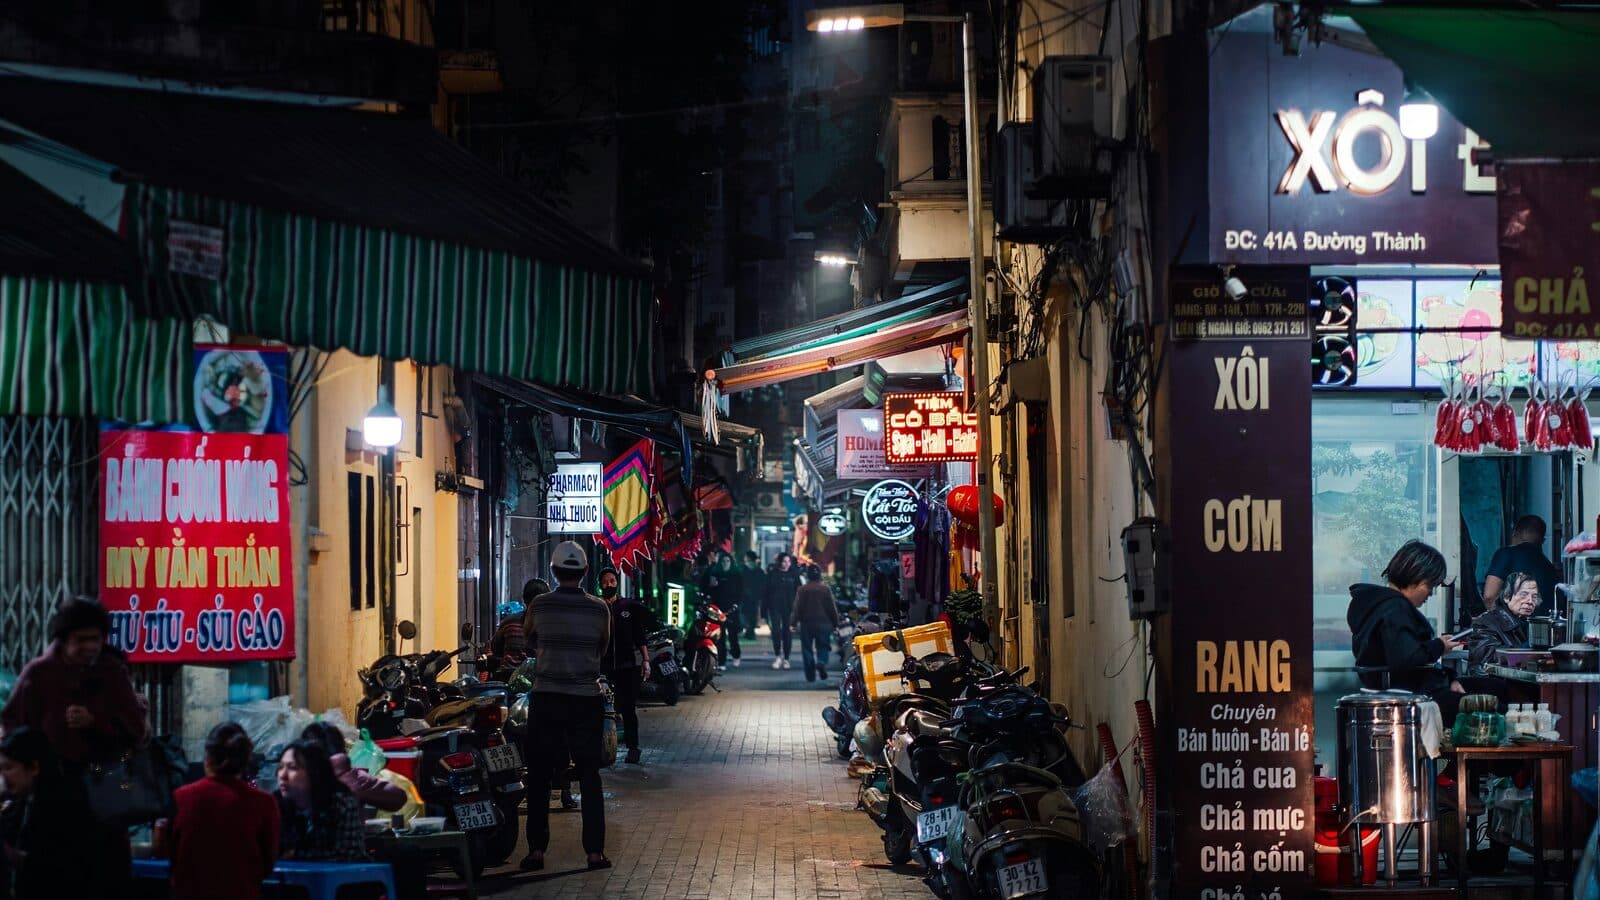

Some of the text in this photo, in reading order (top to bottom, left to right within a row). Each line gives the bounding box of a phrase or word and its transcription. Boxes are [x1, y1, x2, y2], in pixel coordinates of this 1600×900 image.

[1275, 88, 1428, 194] XÔI
[1225, 230, 1426, 254] ĐC: 41A Đường Thành
[1513, 265, 1591, 315] CHẢ
[1208, 318, 1233, 335] NGOÀI
[1274, 321, 1288, 335] 371
[1552, 321, 1588, 336] 41A
[1213, 345, 1269, 410] XÔI
[890, 410, 923, 427] CÔ
[105, 435, 280, 523] BÁNH CUỐN NÓNG
[550, 474, 598, 492] PHARMACY
[569, 499, 598, 522] THUỐC
[891, 497, 918, 513] Tóc
[1203, 494, 1283, 552] CƠM
[106, 527, 281, 589] MỲ VẰN THẮN
[143, 598, 185, 653] TÍU
[196, 593, 235, 652] SỦI
[236, 593, 285, 650] CẢO
[1196, 639, 1292, 693] RANG
[1211, 704, 1276, 724] Chuyên
[1178, 727, 1207, 752] Bán
[1212, 727, 1249, 752] buôn
[1260, 727, 1289, 752] Bán
[1295, 724, 1309, 752] lẻ
[1200, 759, 1296, 789] Chả cua
[1200, 801, 1304, 836] Chả mực
[1200, 841, 1304, 872] Chả cốm
